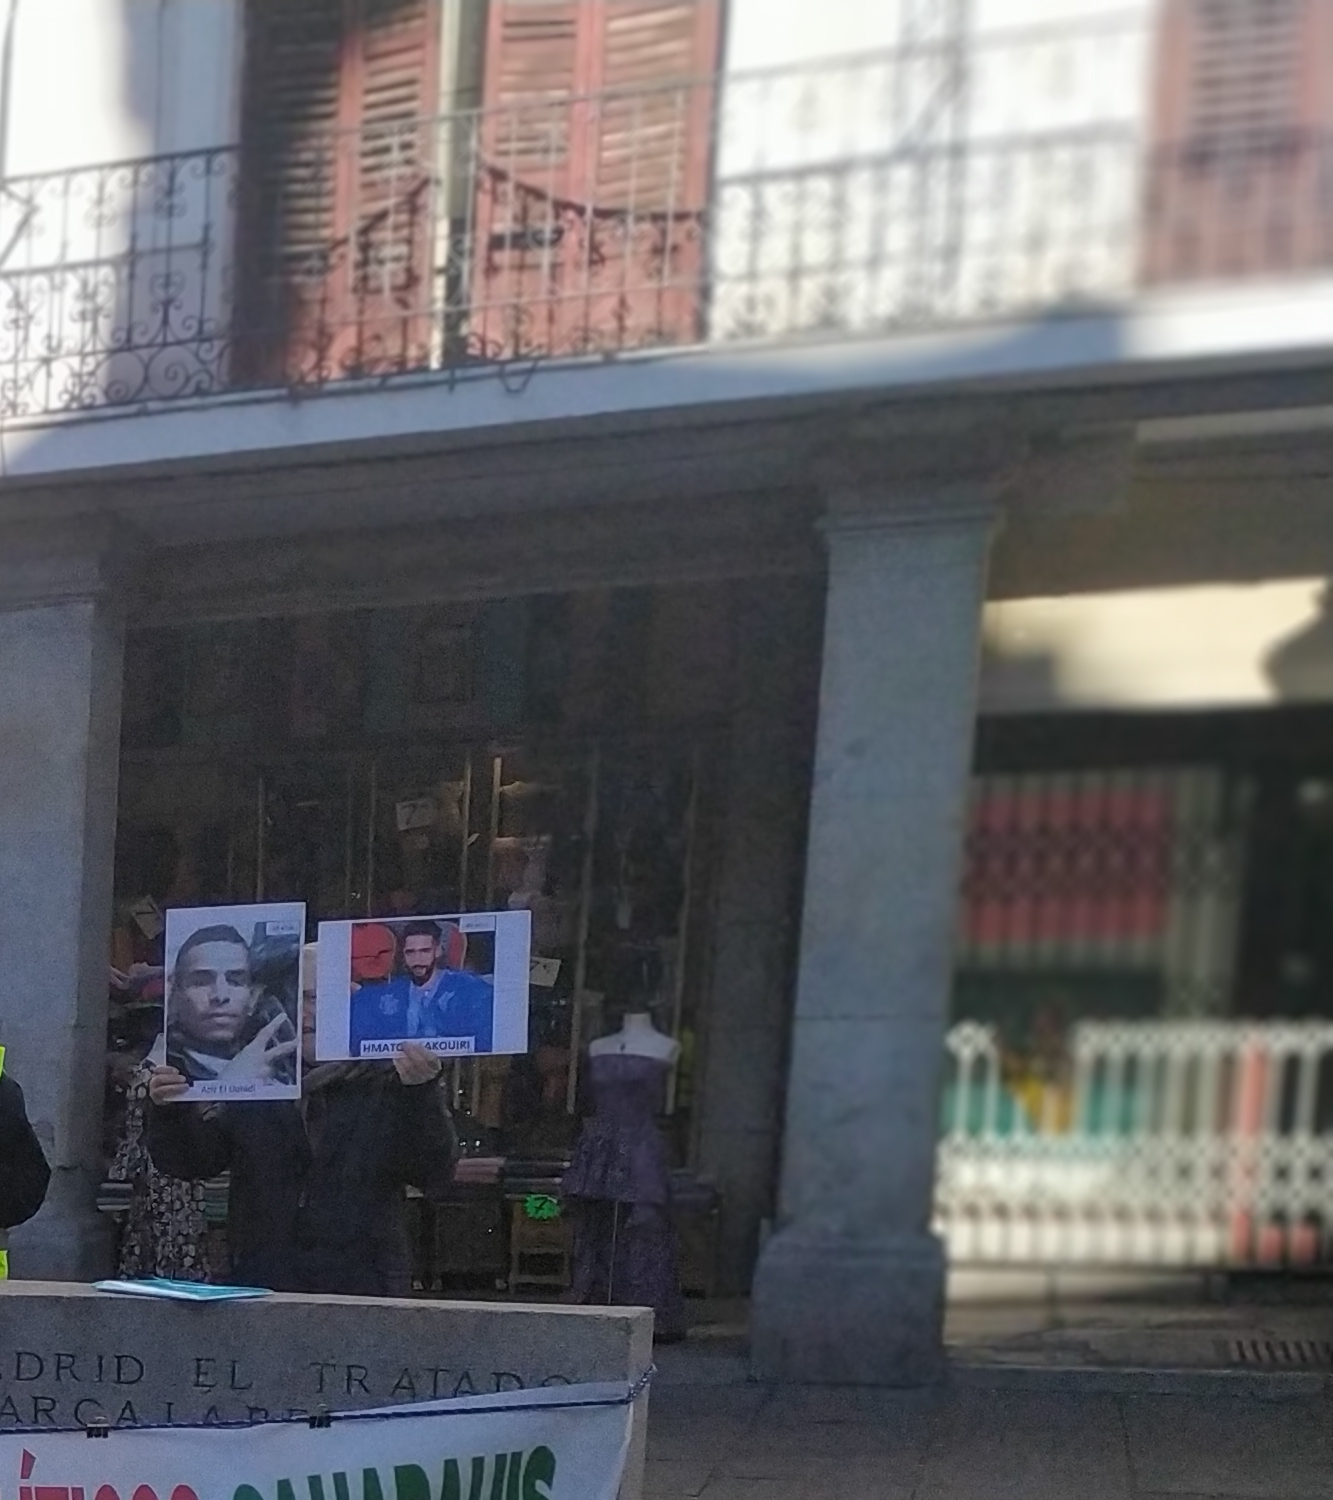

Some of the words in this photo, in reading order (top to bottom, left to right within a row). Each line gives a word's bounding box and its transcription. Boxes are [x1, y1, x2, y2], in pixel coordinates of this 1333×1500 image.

[363, 1042, 404, 1053] HMATO
[424, 1040, 471, 1051] AKOUIRI
[193, 1358, 254, 1391] EL
